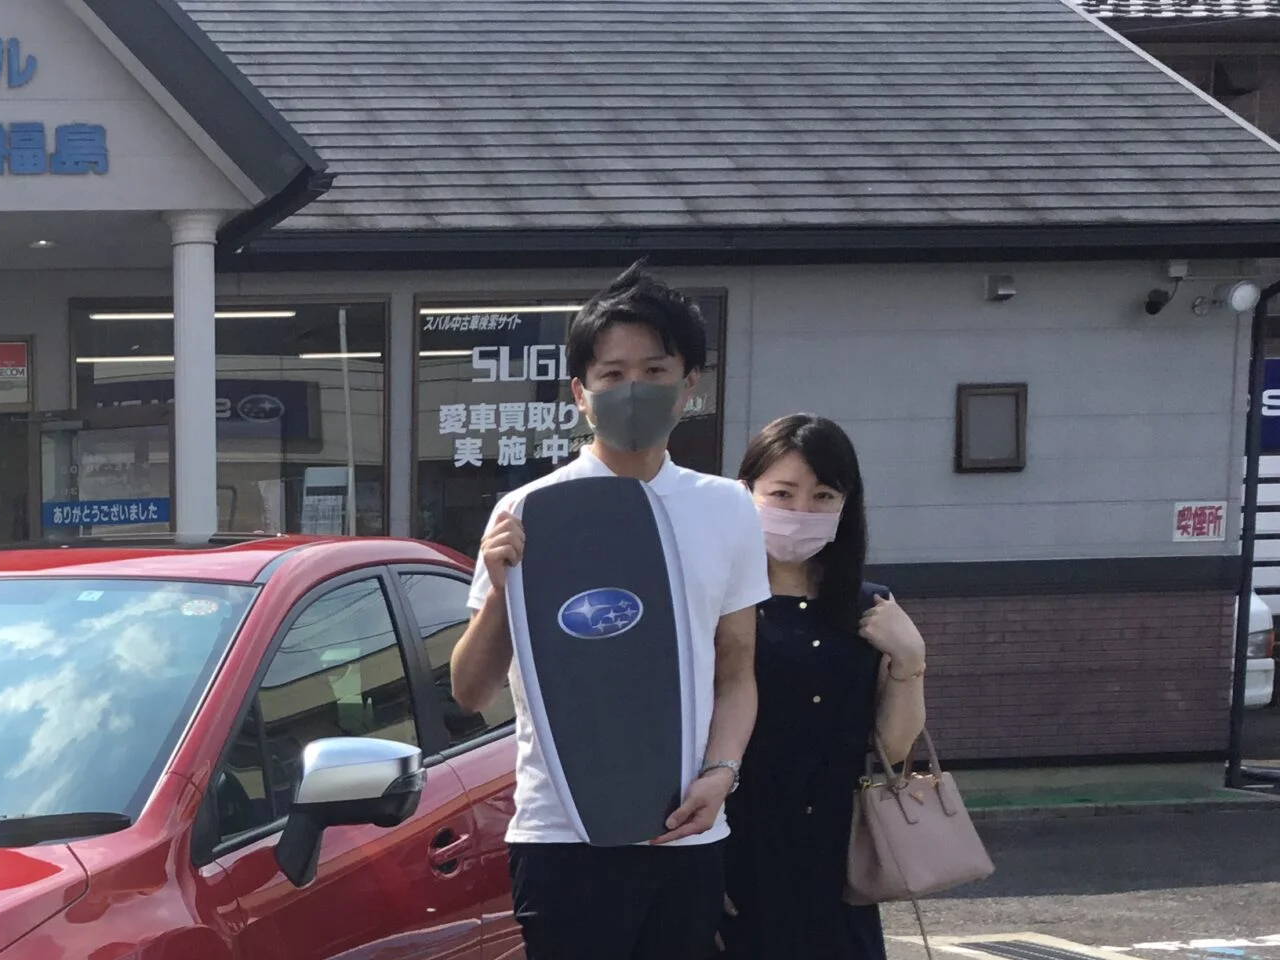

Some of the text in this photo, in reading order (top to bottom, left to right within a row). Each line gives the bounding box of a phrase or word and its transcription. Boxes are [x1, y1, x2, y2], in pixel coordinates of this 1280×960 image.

[423, 313, 522, 331] スバル中古車検索サイト
[439, 401, 579, 434] 愛車買取り
[53, 502, 158, 524] ありがとうございました
[1176, 505, 1223, 537] 喫煙所
